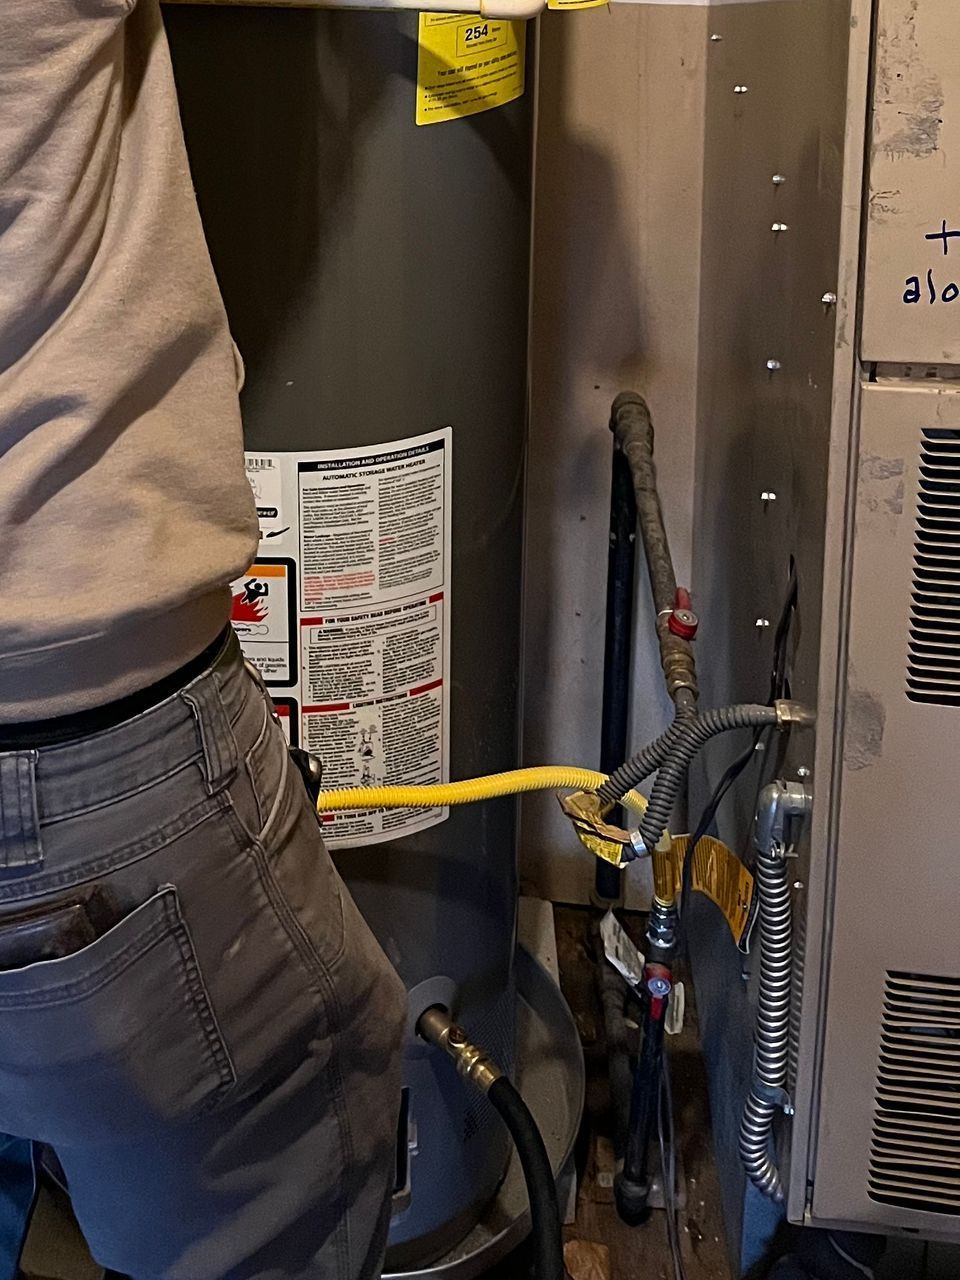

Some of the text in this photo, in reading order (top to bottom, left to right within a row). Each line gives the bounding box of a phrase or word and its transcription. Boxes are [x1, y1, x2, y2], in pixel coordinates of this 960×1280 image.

[464, 24, 489, 41] 254
[317, 446, 430, 469] INSTALLATION AND OPERATION DETAILS
[322, 459, 426, 481] AUTOMATIC STORAGE WATER HEATER
